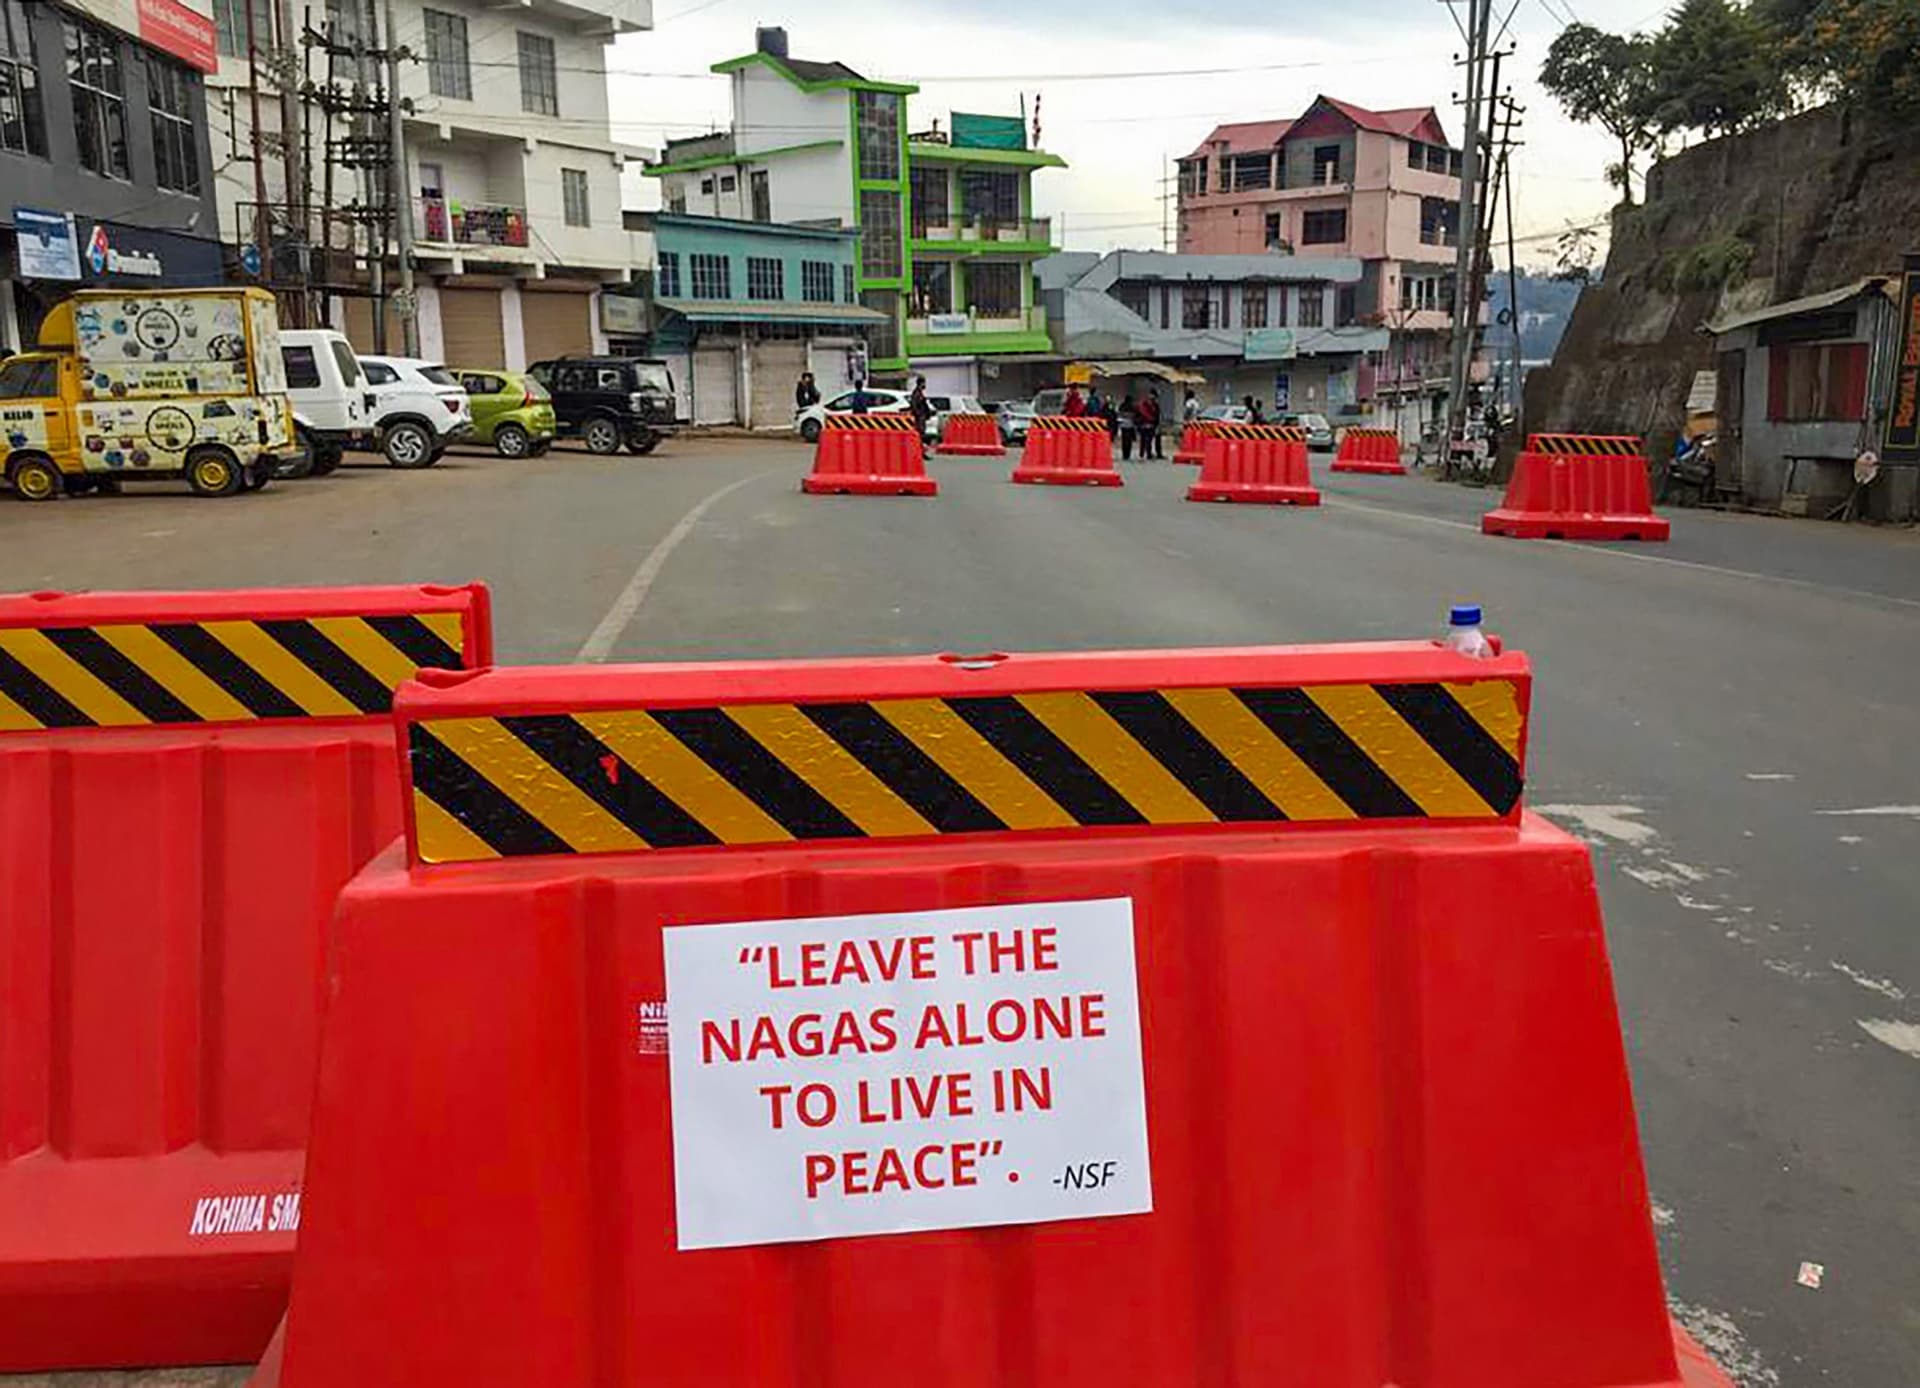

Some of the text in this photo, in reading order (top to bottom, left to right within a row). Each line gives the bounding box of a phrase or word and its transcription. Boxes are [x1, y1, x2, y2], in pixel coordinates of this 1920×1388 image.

[739, 928, 1058, 990] “LEAVE THE
[701, 994, 1105, 1063] NAGAS ALONE
[760, 1068, 1053, 1129] TO LIVE IN
[1053, 1160, 1117, 1191] -NSF
[188, 1195, 267, 1236] KOHIMA
